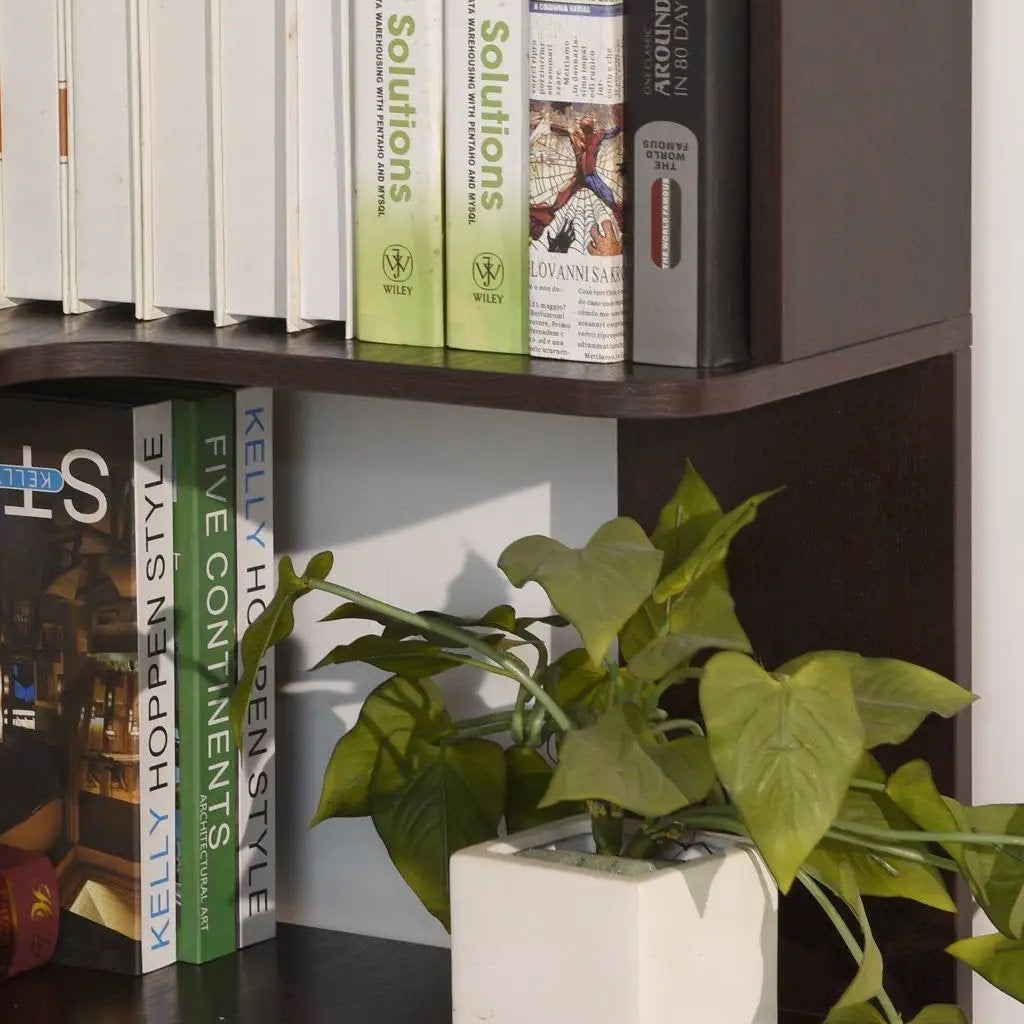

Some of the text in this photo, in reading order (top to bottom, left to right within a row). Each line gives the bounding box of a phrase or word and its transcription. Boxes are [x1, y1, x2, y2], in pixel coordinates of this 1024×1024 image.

[375, 12, 383, 83] WAREHOUSING
[467, 18, 476, 90] WAREHOUSING
[674, 46, 688, 69] 80
[376, 86, 384, 111] WITH
[674, 75, 688, 96] IN
[387, 14, 416, 203] Solutions
[467, 93, 475, 118] WITH
[480, 20, 510, 211] Solutions
[376, 114, 384, 159] PENTAHO
[467, 121, 476, 166] PENTAHO
[642, 139, 689, 152] FAMOUS
[646, 150, 686, 161] WORLD
[654, 160, 677, 171] THE
[377, 162, 385, 182] AND
[467, 169, 476, 189] AND
[378, 185, 386, 217] MYSQL
[468, 192, 476, 225] MYSQL
[383, 284, 413, 296] WILEY
[473, 292, 504, 304] WILEY
[244, 407, 266, 549] KELLY
[205, 435, 231, 851] FIVE CONTINENTS
[143, 433, 170, 951] KELLY HOPPEN STYLE
[248, 771, 269, 918] STYLE
[199, 794, 209, 931] ARCHITECTURAL ART
